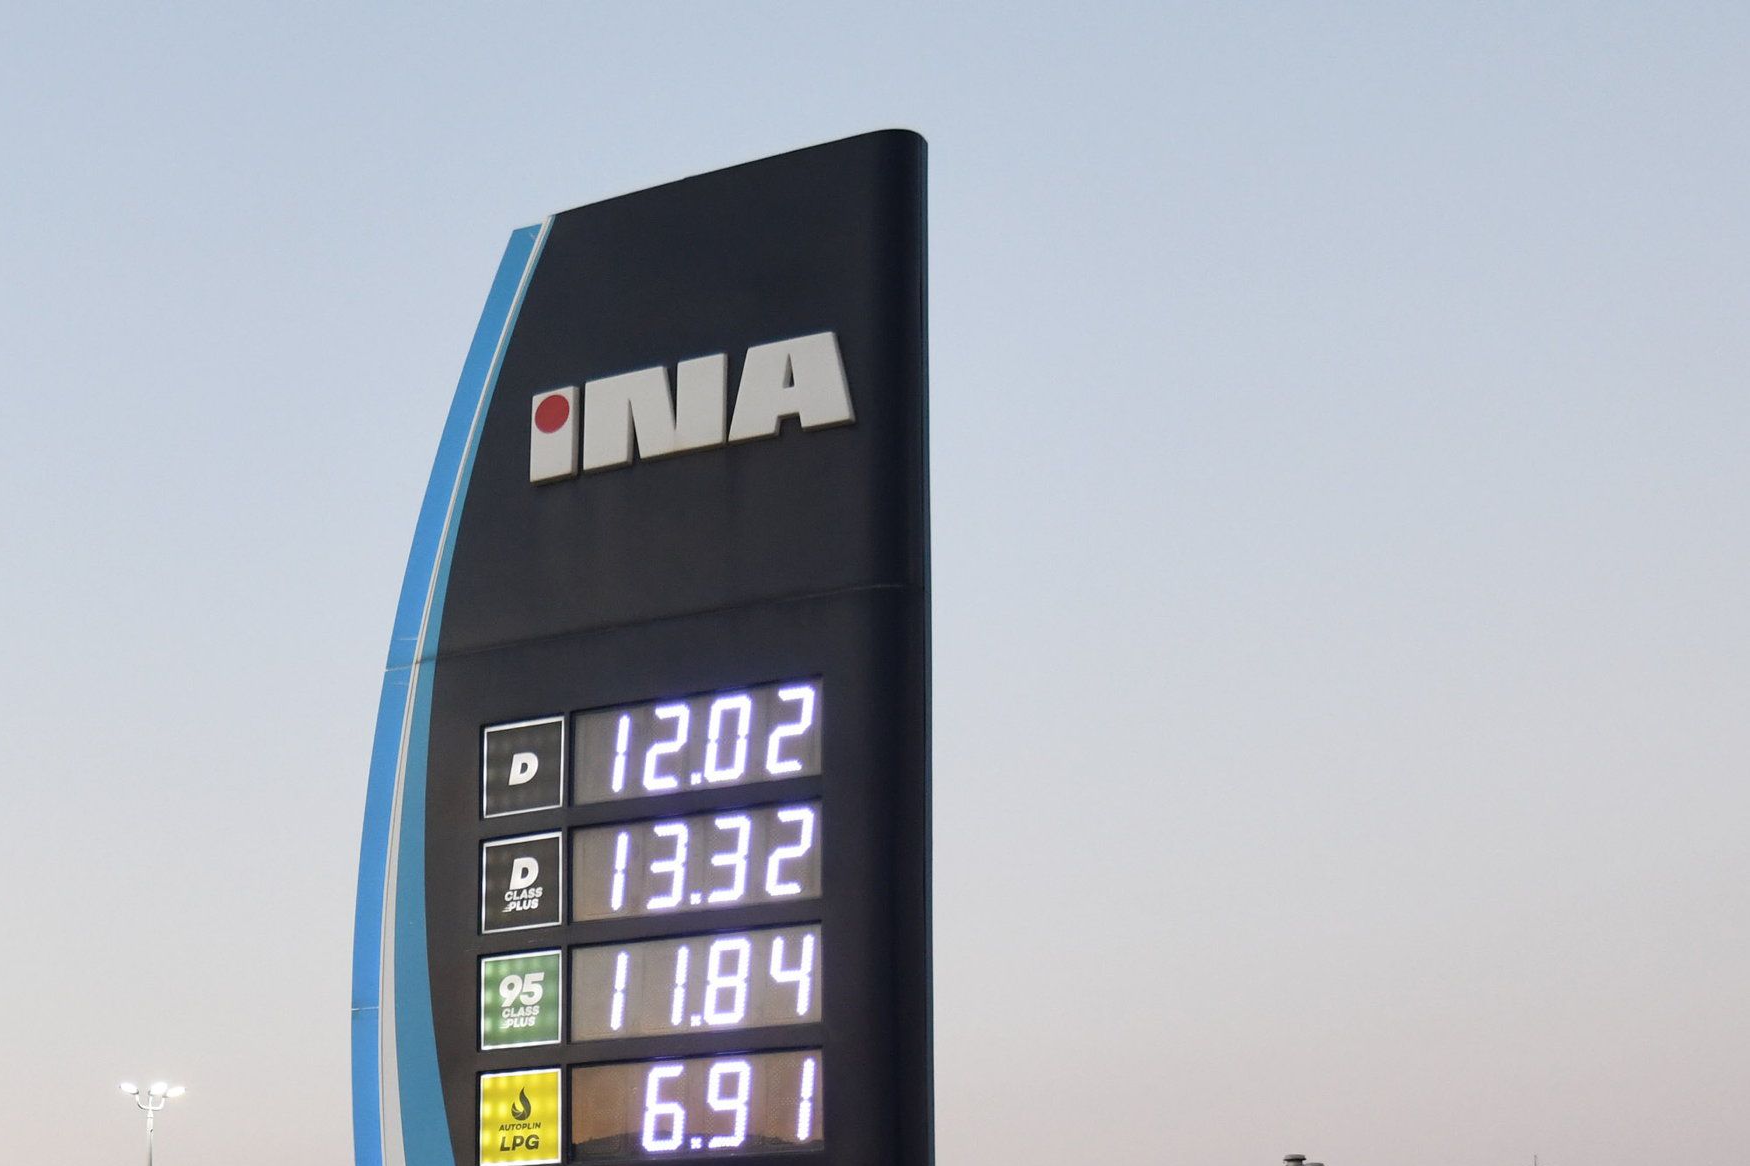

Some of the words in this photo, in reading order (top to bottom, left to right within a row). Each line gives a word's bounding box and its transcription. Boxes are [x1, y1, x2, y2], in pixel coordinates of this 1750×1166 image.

[609, 685, 817, 793] 12.02
[508, 751, 540, 786] D
[509, 856, 540, 890] D
[609, 806, 816, 912] 13.32
[503, 898, 540, 913] PLUS
[504, 886, 543, 901] CLASS
[499, 971, 545, 1008] 95
[609, 933, 816, 1032] 11.84
[499, 1016, 536, 1029] PLUS
[501, 1005, 540, 1019] CLASS
[641, 1057, 816, 1153] 6.91
[498, 1122, 542, 1132] AUTOPLIN
[499, 1134, 540, 1152] LPG
